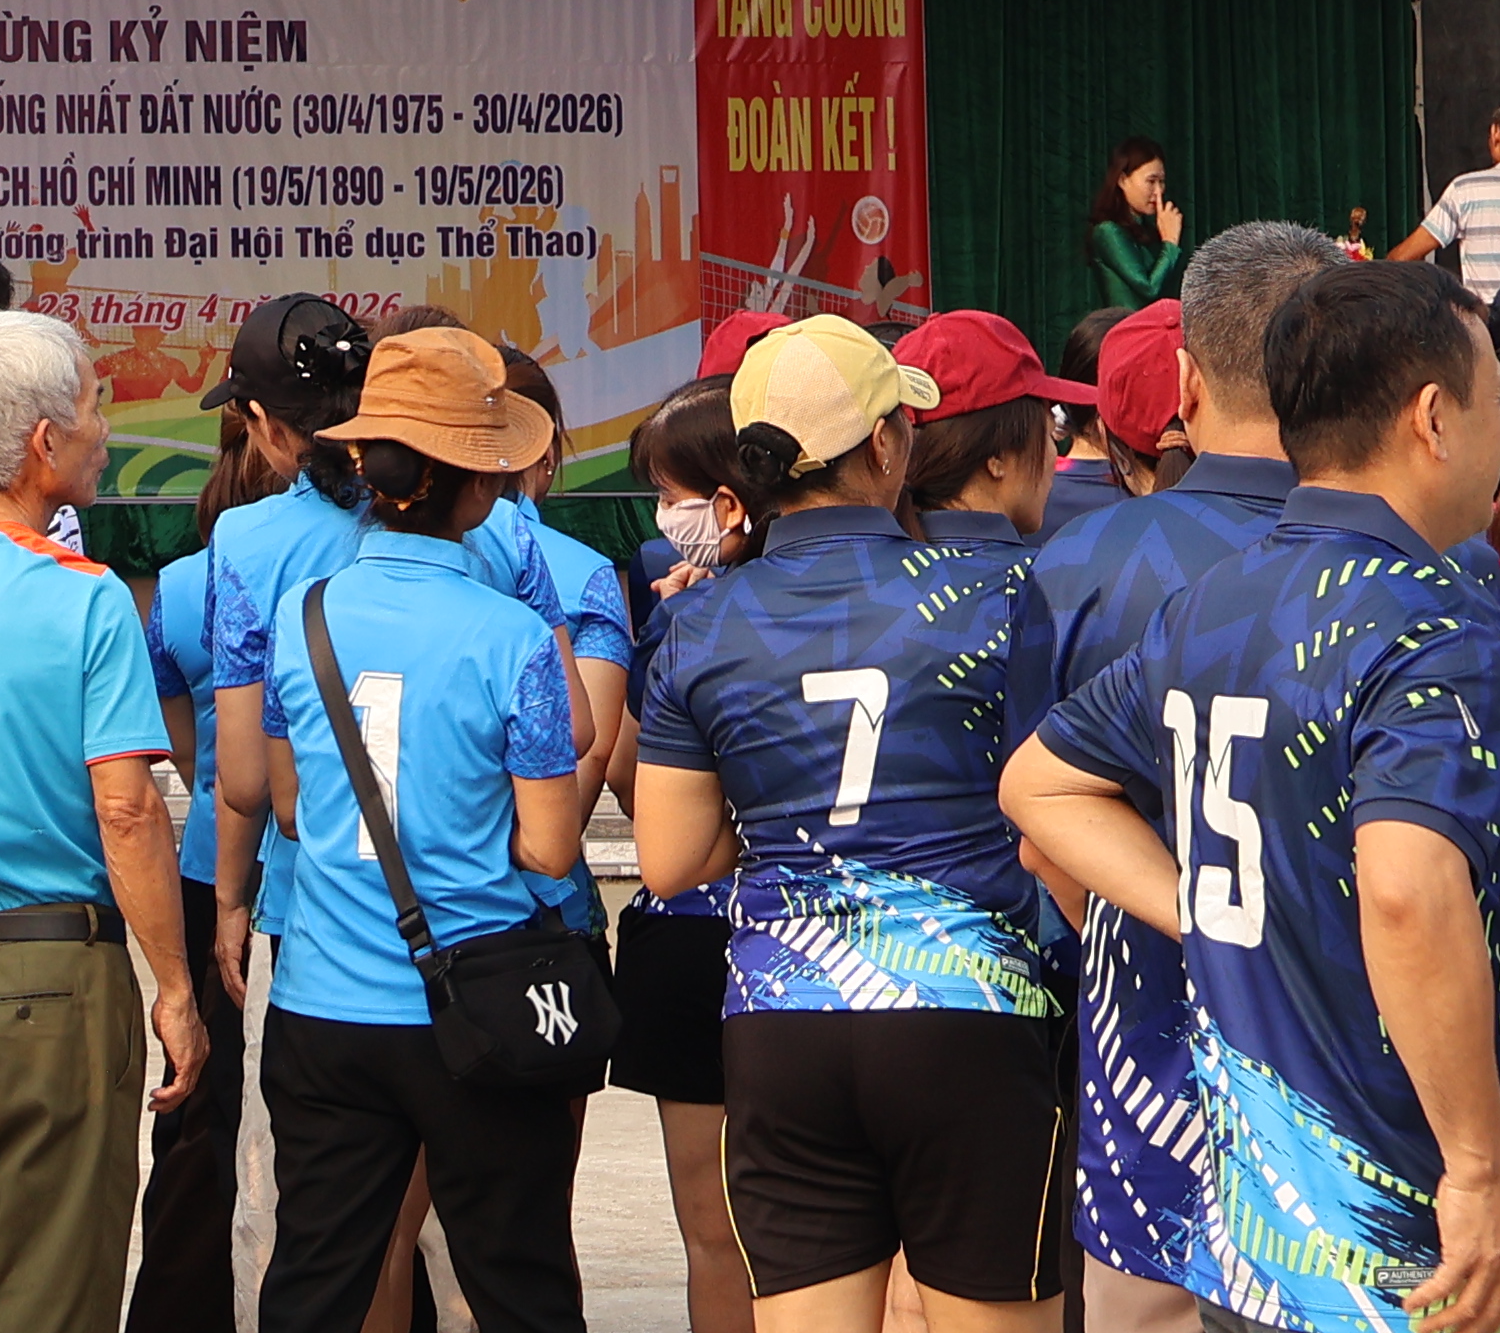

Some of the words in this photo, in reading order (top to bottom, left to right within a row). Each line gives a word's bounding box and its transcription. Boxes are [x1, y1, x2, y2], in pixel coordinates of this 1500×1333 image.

[110, 5, 168, 63] KỶ
[186, 11, 307, 72] NIỆM
[56, 79, 131, 134] NHẤT
[139, 80, 194, 134] ĐẤT
[204, 86, 281, 134] NƯỚC
[293, 93, 443, 138] (30/4/1975
[473, 92, 623, 138] 30/4/2026)
[727, 80, 812, 172] ĐOÀN
[822, 71, 875, 171] KẾT
[886, 96, 896, 171] !
[40, 152, 77, 206] HỒ
[88, 157, 135, 206] CHÍ
[146, 166, 221, 206] MINH
[232, 165, 384, 209] (19/5/1890
[414, 164, 563, 209] 19/5/2026)
[76, 227, 153, 259] trình
[165, 227, 218, 265] Đại
[231, 227, 283, 265] Hội
[295, 219, 354, 259] Thể
[366, 227, 425, 265] dục
[436, 219, 496, 259] Thể
[506, 226, 597, 261] Thao)
[38, 293, 79, 323] 23
[91, 293, 184, 331] tháng
[198, 293, 217, 324] 4
[802, 668, 889, 826] 7
[1163, 688, 1269, 948] 15
